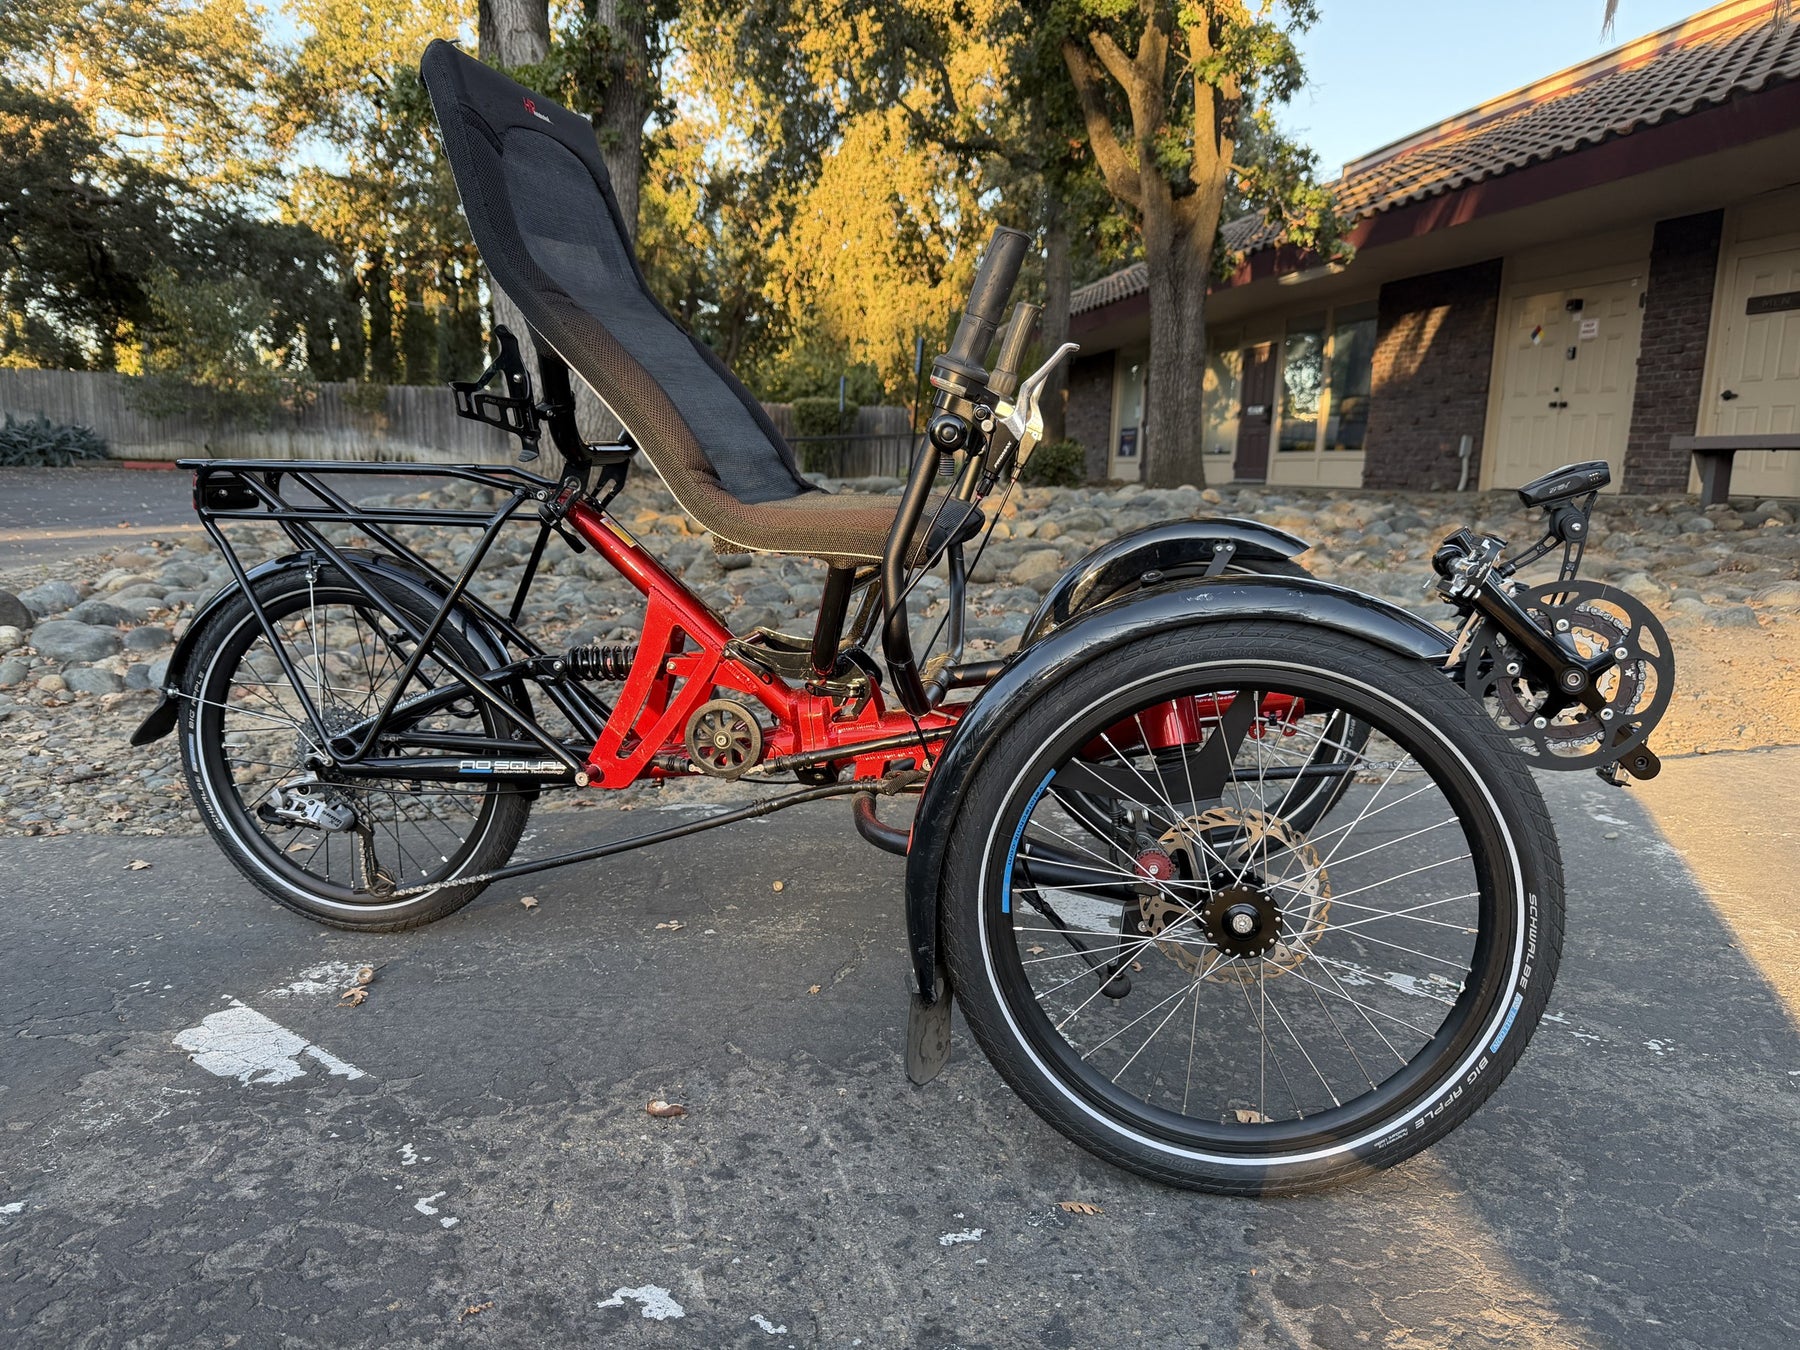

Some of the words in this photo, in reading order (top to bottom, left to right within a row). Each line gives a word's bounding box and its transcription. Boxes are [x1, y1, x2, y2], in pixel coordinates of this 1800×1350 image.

[1520, 892, 1538, 989] SCHWALBE
[1467, 1057, 1489, 1085] BIG
[1415, 1086, 1462, 1129] APPLE
